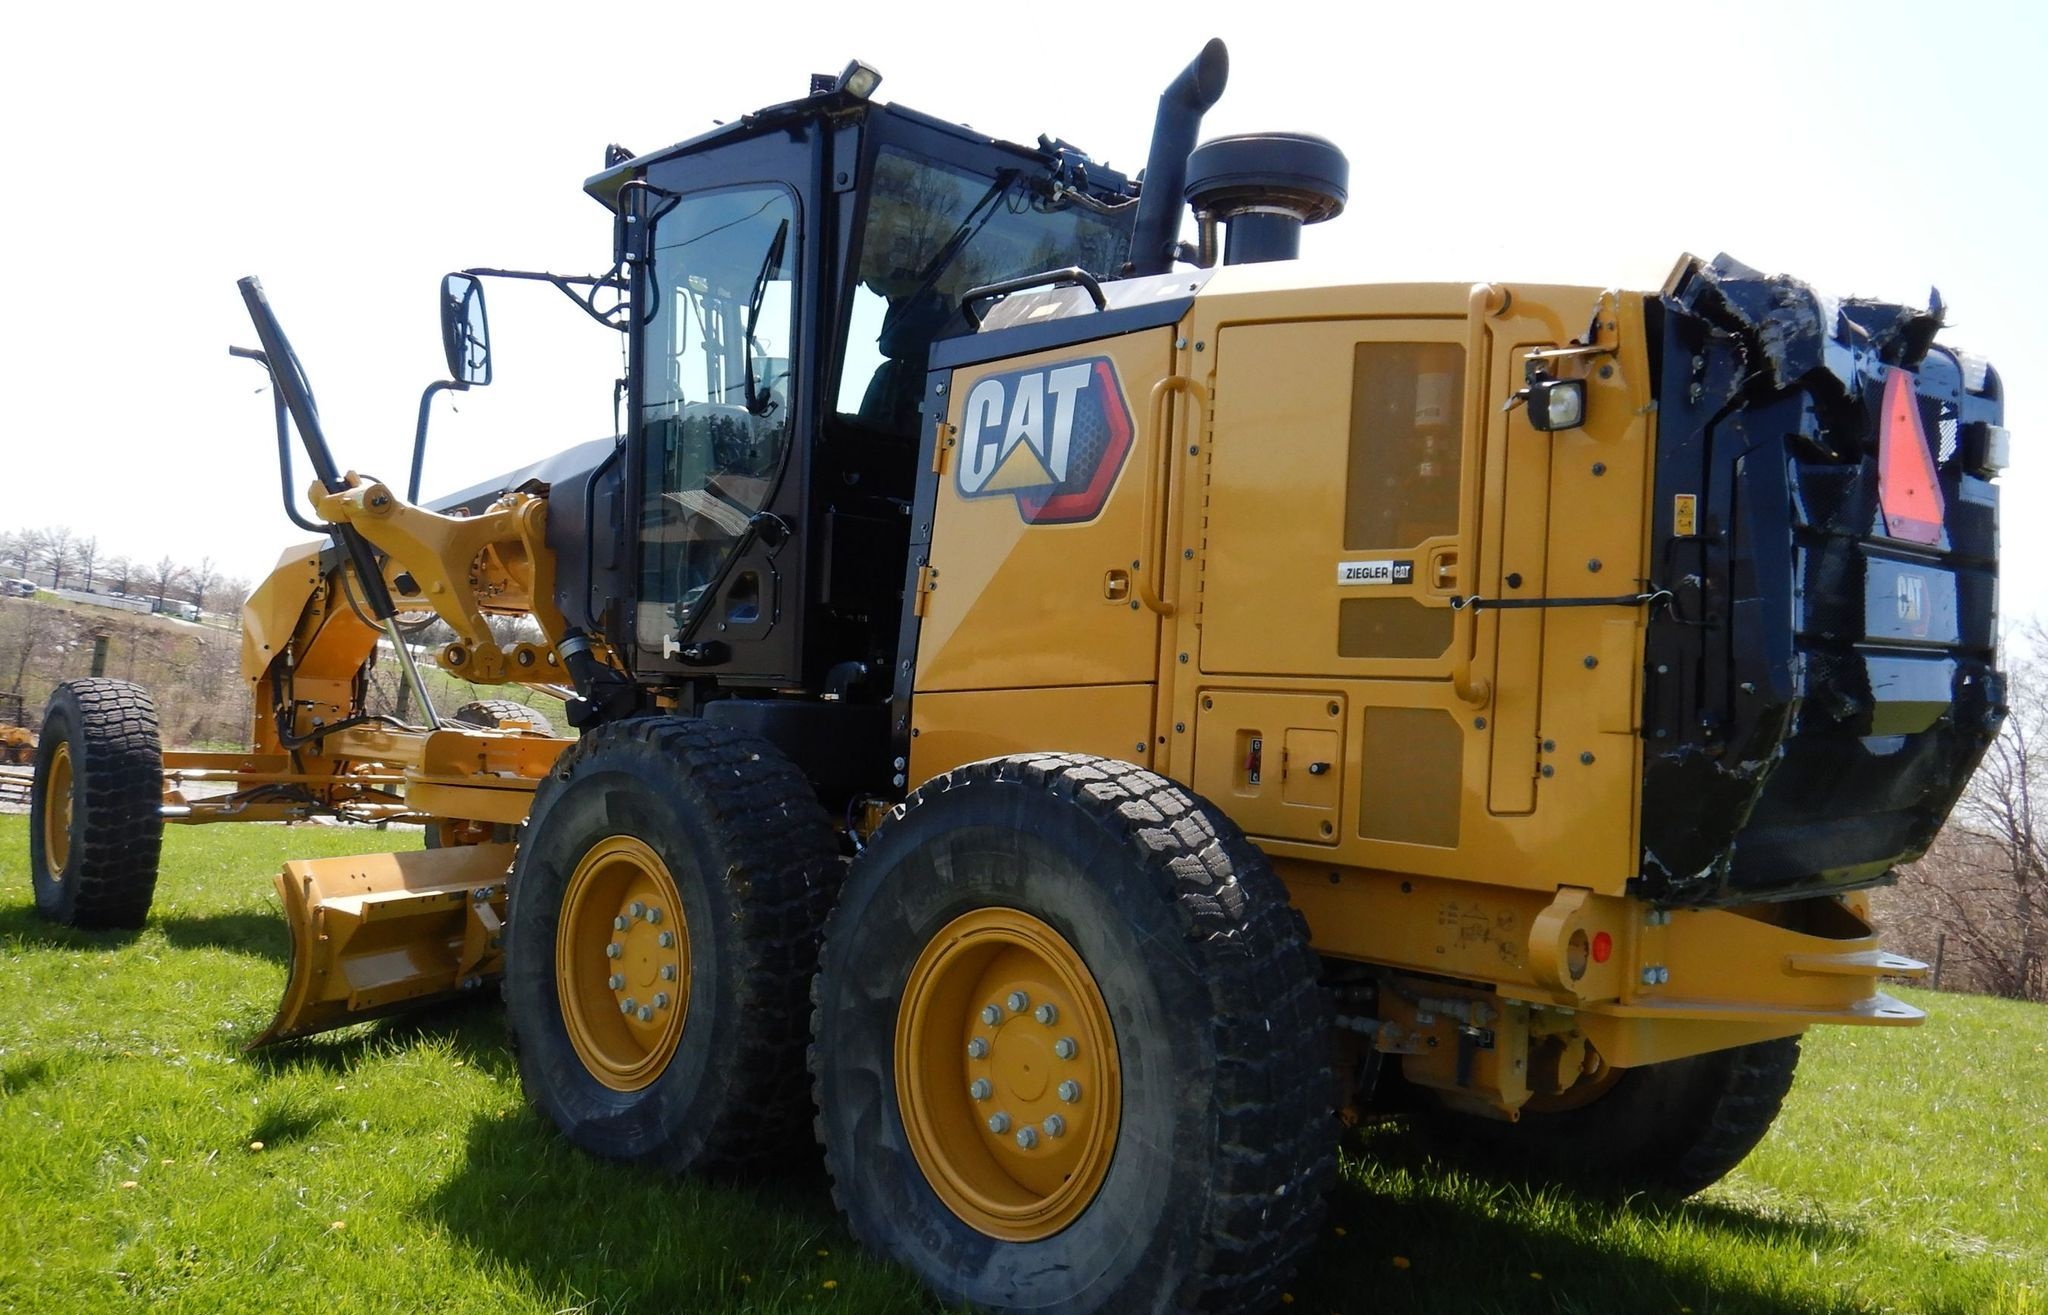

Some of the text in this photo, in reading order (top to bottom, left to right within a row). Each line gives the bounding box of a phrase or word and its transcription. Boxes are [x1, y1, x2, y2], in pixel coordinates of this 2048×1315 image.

[960, 363, 1091, 492] CAT
[1346, 566, 1410, 579] ZIEGLER CAT
